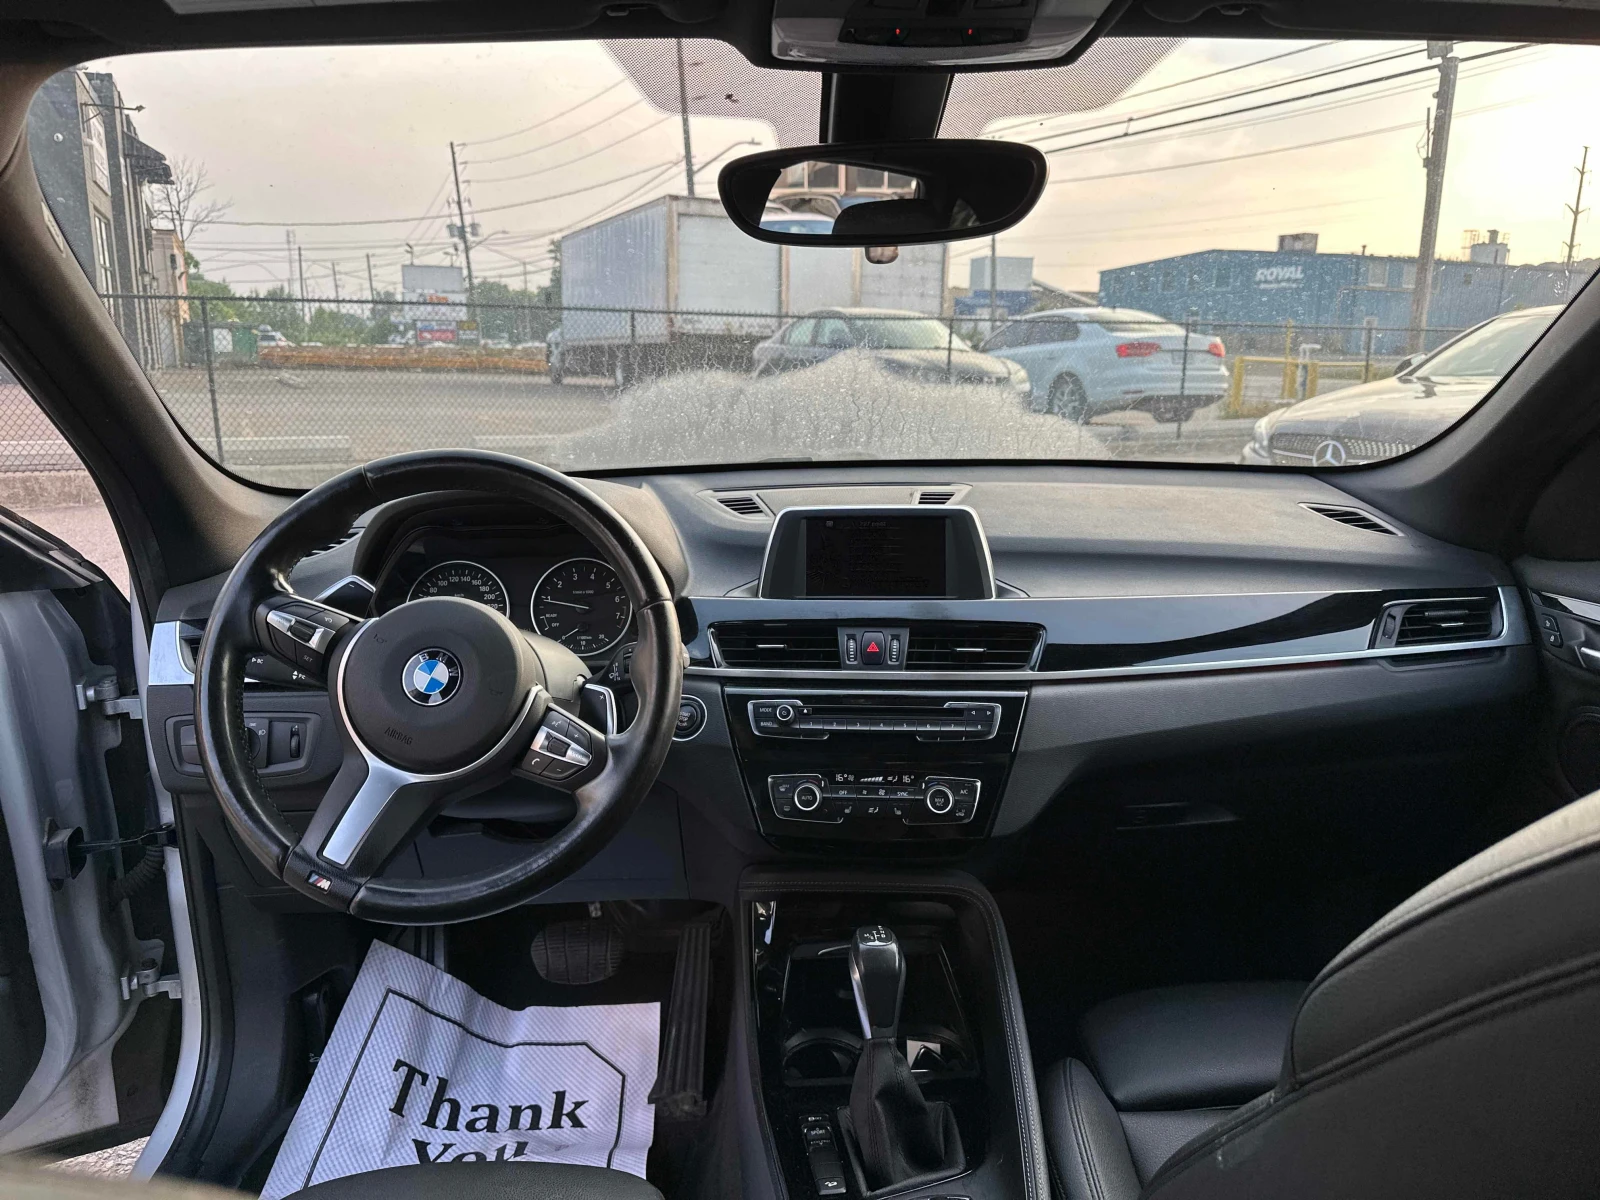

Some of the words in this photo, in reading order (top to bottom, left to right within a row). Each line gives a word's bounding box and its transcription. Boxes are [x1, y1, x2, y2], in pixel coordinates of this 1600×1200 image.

[1255, 266, 1304, 281] ROYAL
[418, 652, 458, 677] BMW
[384, 726, 413, 746] AIRBAG
[389, 1058, 589, 1133] Thank
